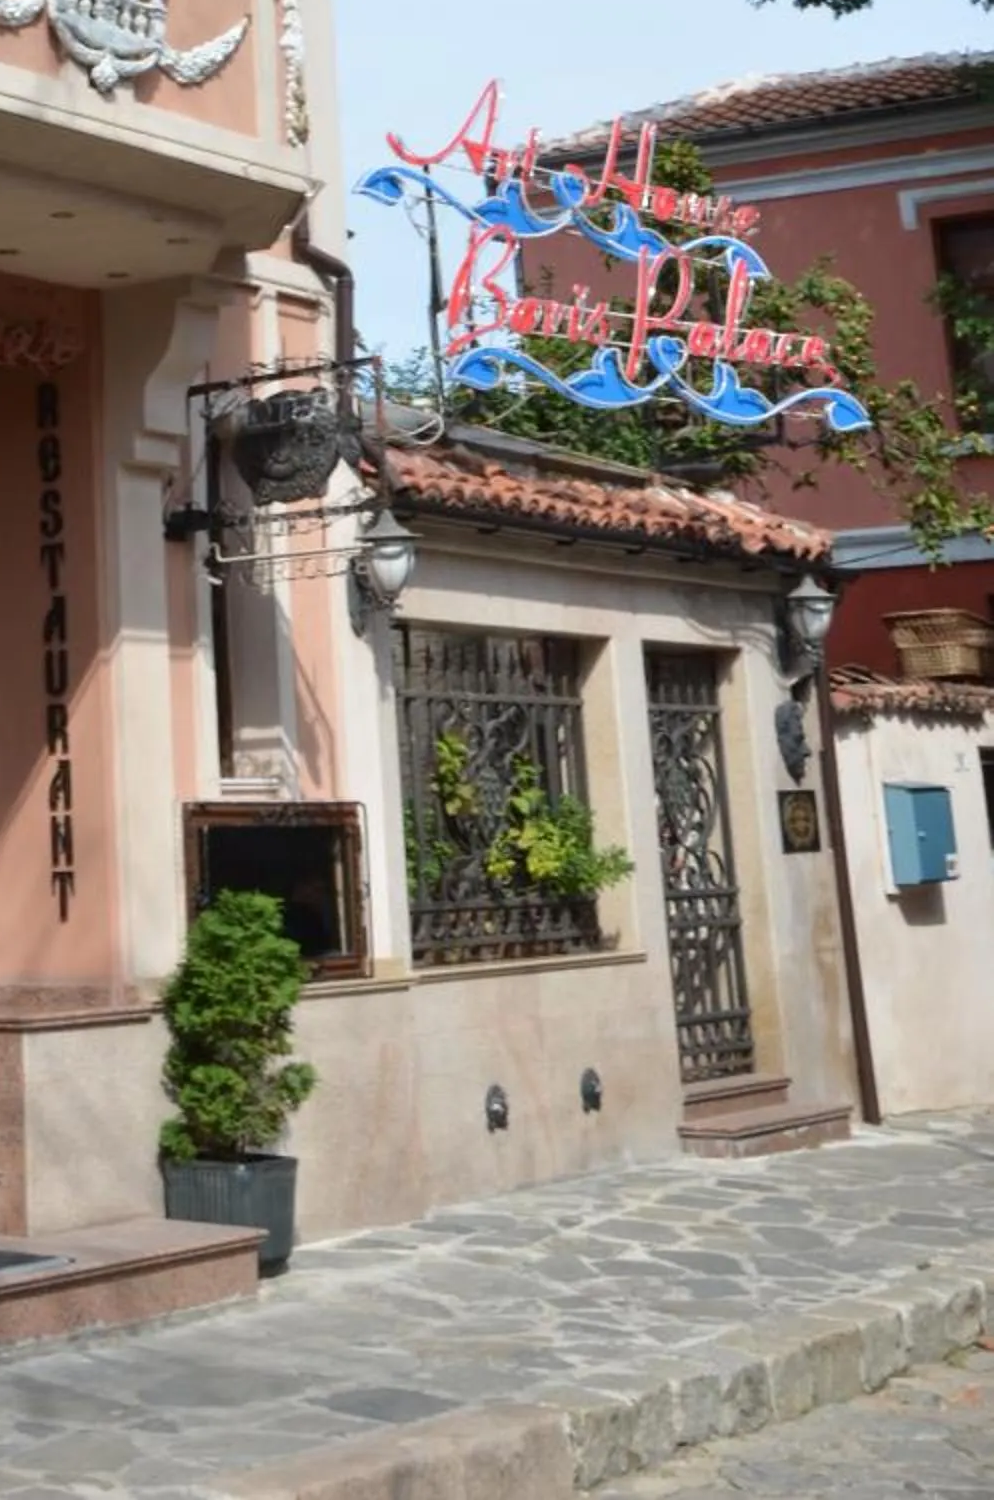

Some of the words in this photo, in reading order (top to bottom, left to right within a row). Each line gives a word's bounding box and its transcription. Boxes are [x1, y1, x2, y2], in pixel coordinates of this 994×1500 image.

[446, 222, 610, 356] Boris
[626, 244, 842, 385] Palace
[36, 382, 75, 922] RESTAURANT
